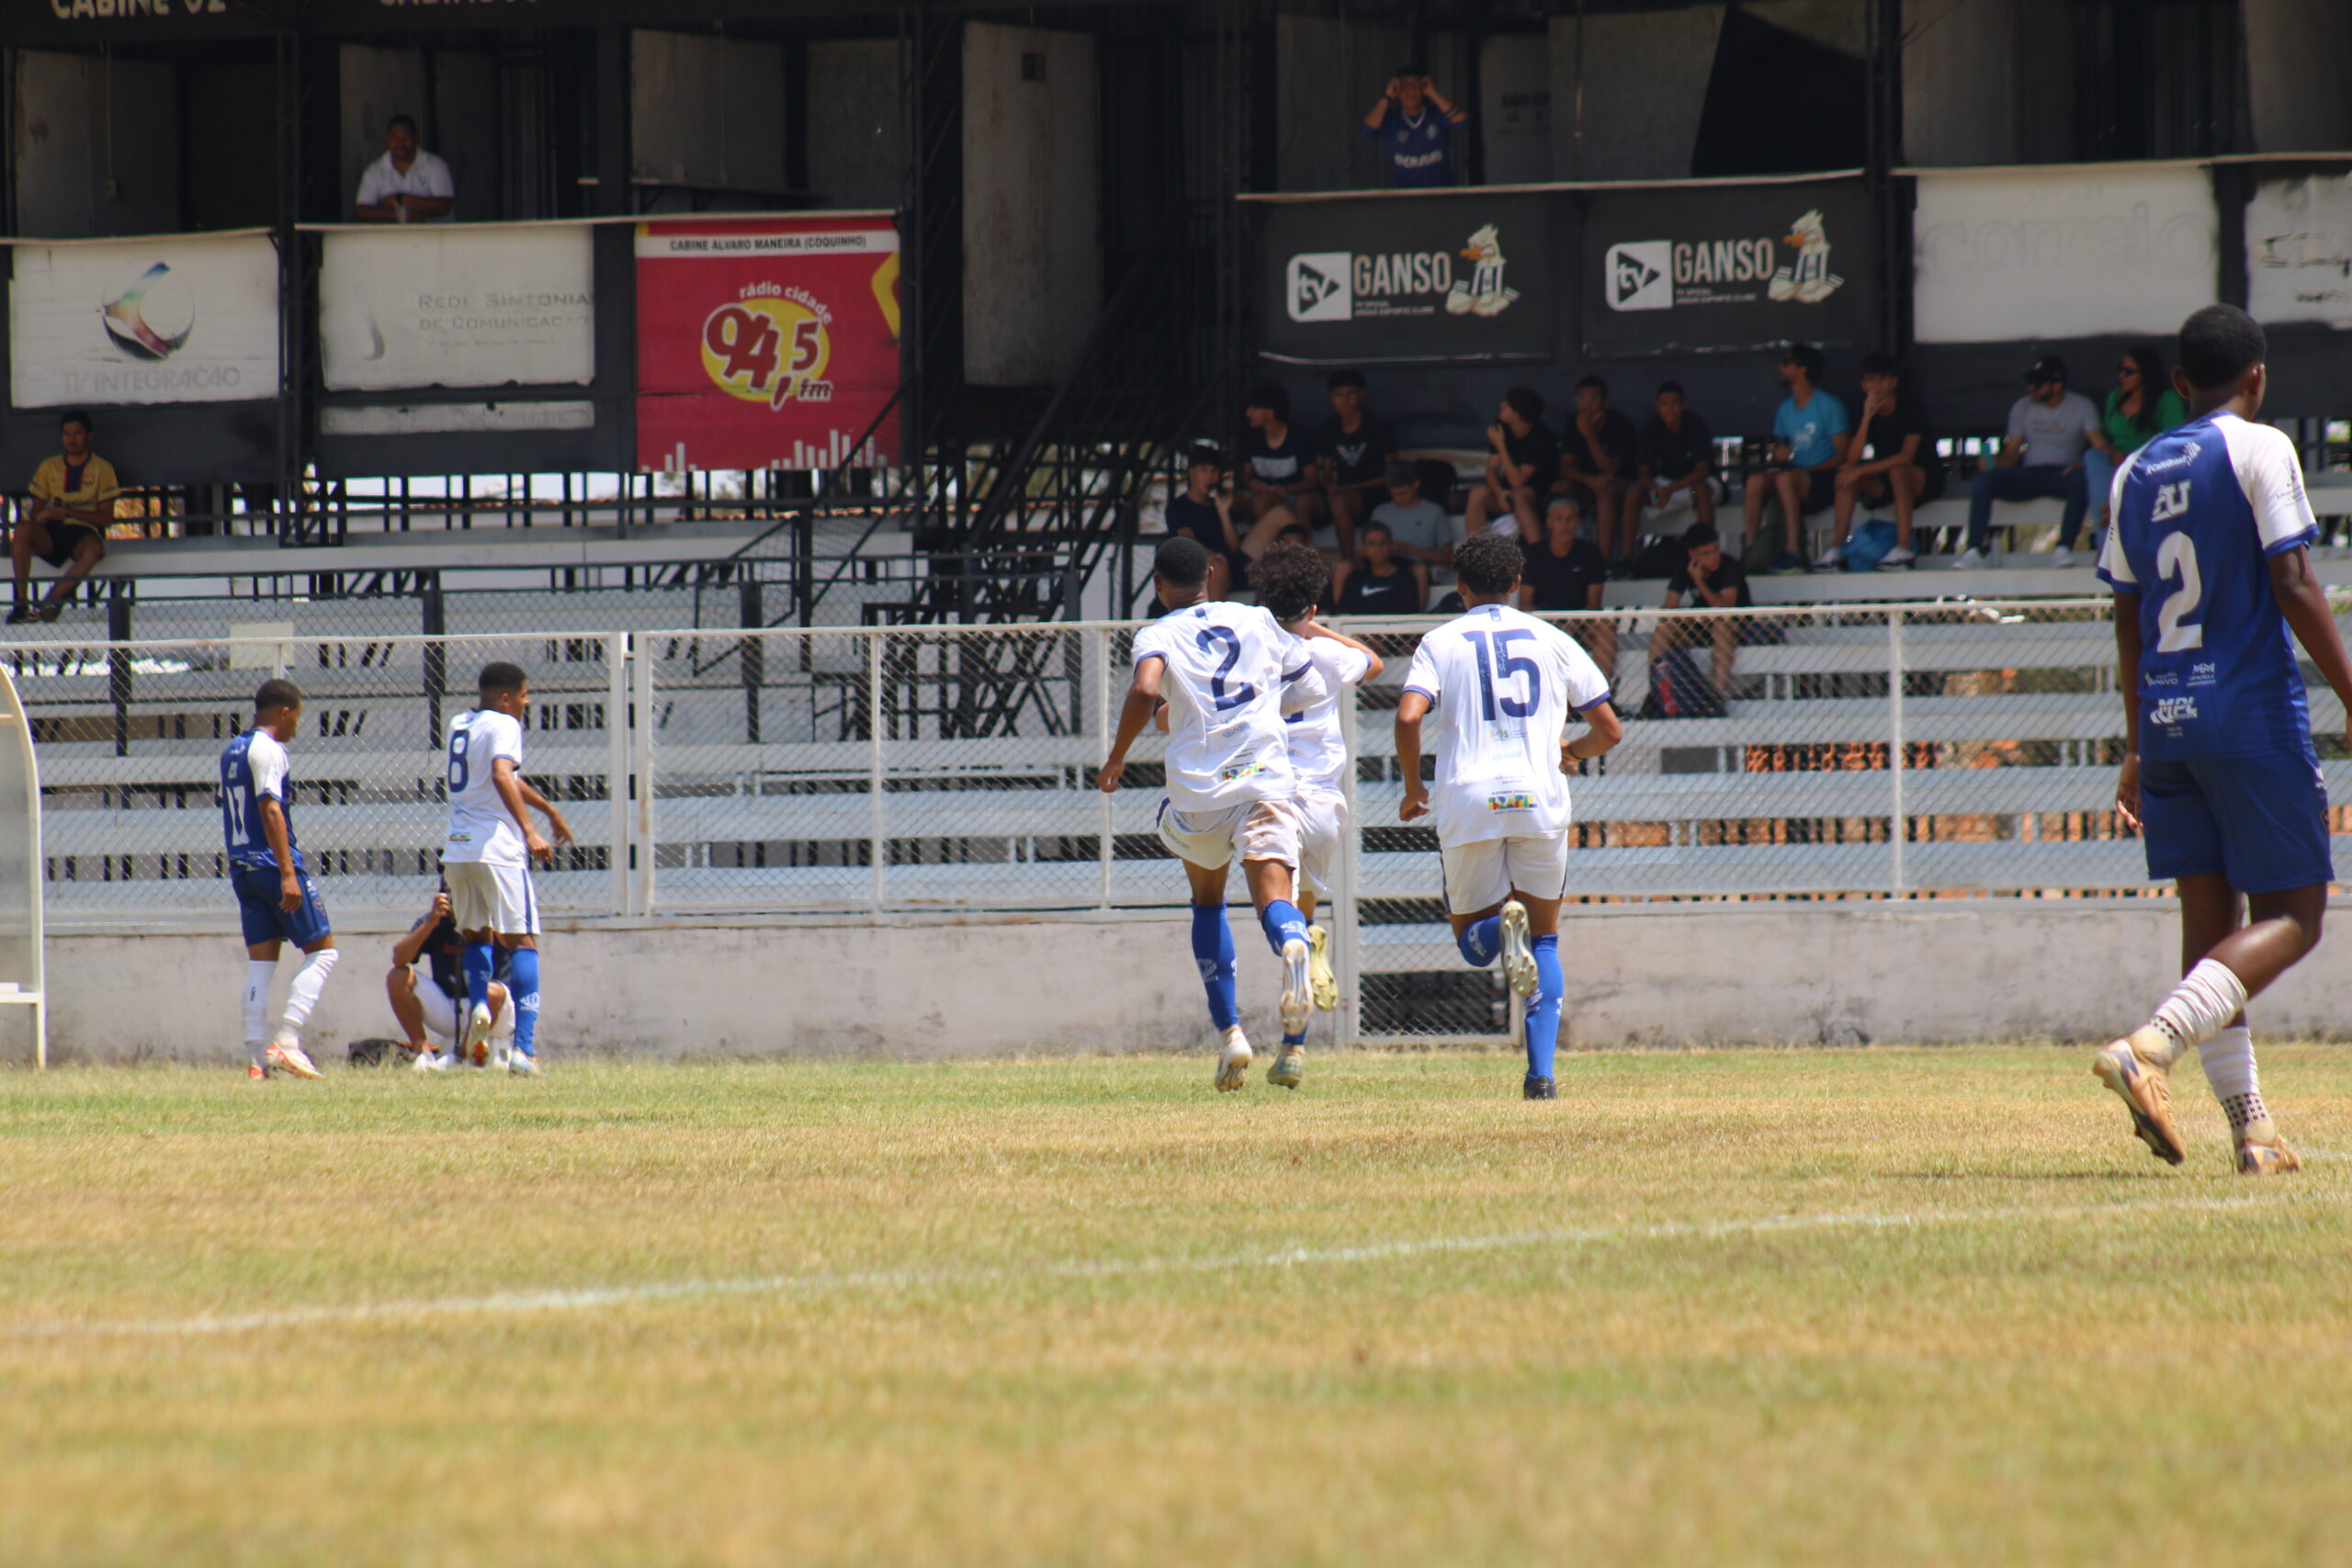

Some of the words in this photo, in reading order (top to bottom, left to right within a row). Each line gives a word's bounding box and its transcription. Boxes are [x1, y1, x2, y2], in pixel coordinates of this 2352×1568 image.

[670, 239, 709, 252] CABINE
[754, 237, 801, 250] MANEIRA
[804, 235, 866, 249] (COQUINHO)
[1674, 238, 1775, 284] GANSO
[1353, 252, 1452, 297] GANSO
[740, 281, 782, 299] rádio
[785, 285, 832, 323] cidade
[797, 378, 834, 402] fm
[2156, 530, 2202, 653] 2
[1195, 625, 1256, 712] 2
[1461, 628, 1541, 721] 15
[447, 729, 469, 793] 8
